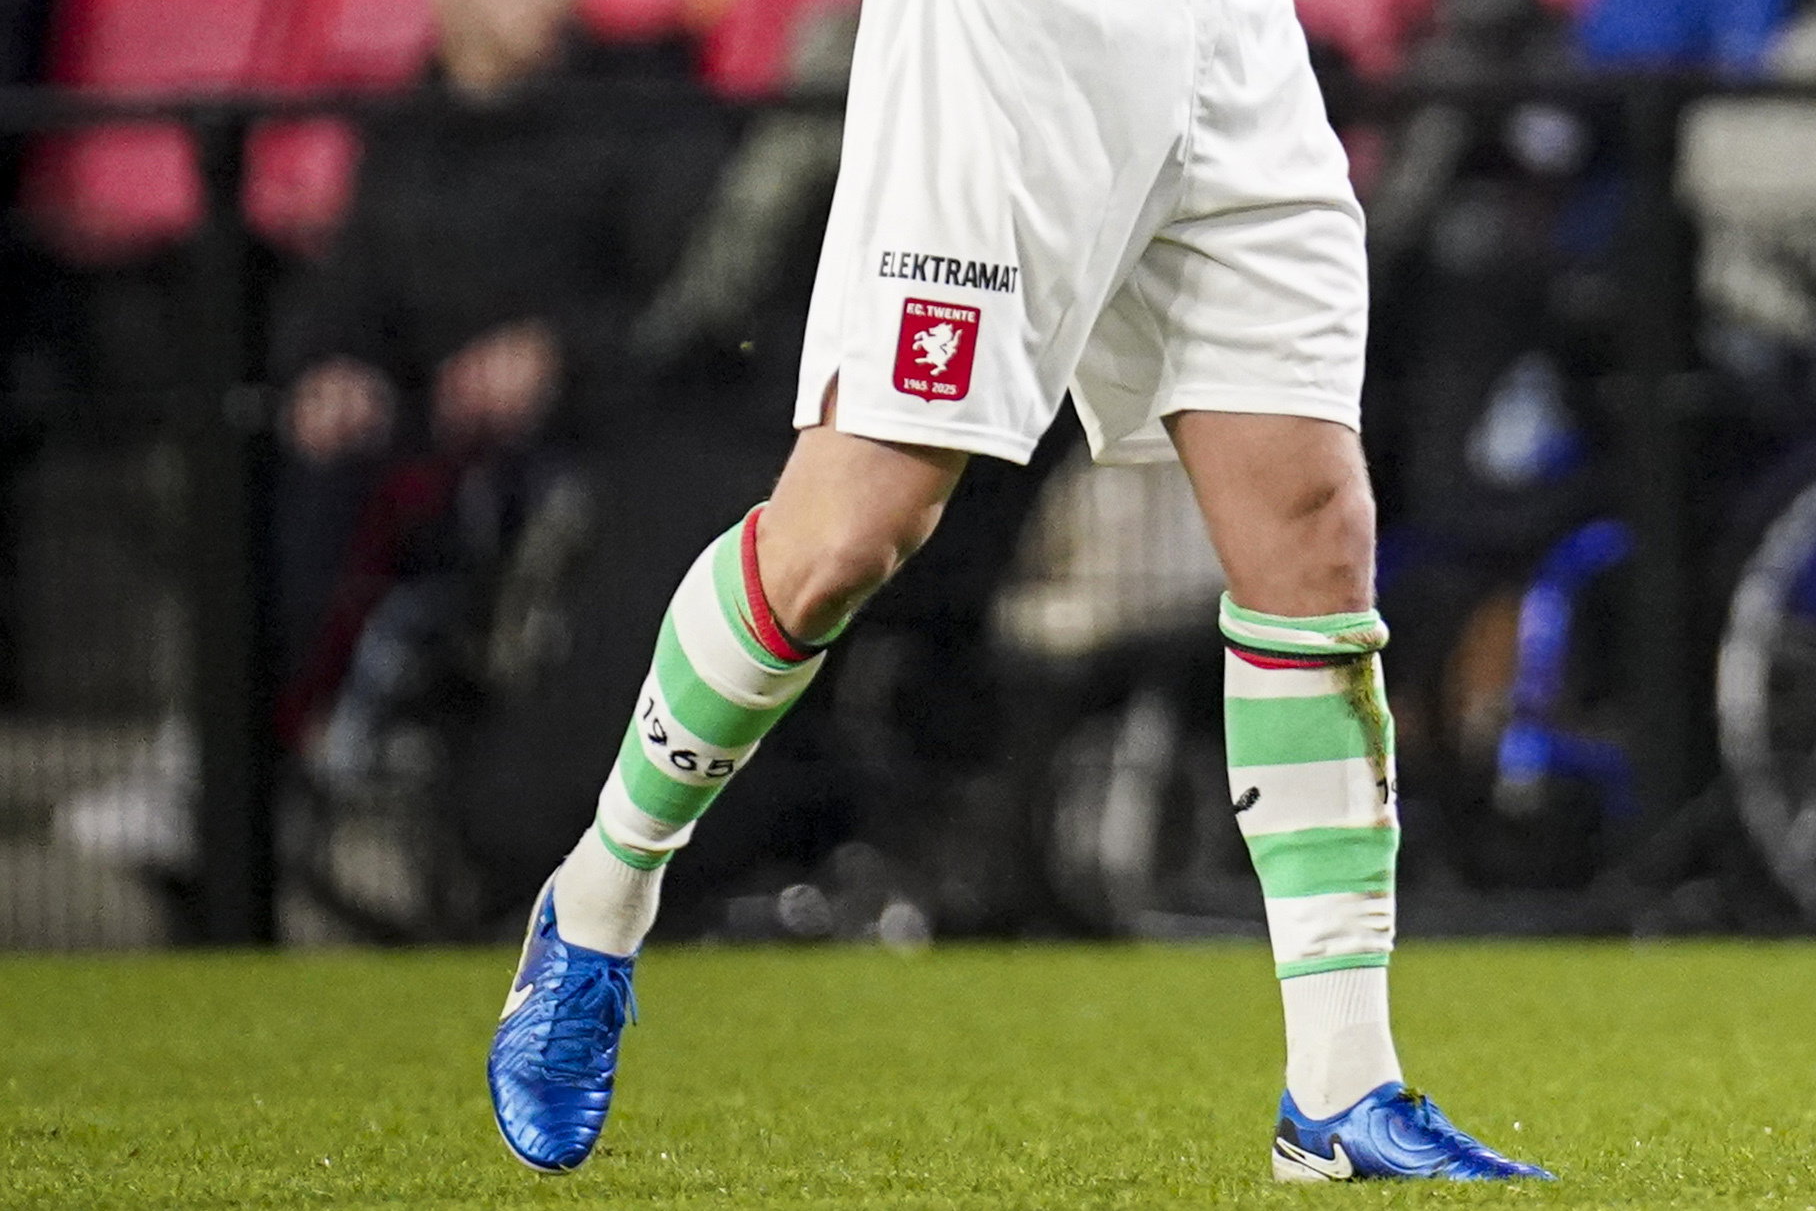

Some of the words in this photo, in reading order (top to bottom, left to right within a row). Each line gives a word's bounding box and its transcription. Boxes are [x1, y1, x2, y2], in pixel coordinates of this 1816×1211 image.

[878, 251, 1018, 294] ELEKTRAMAT
[926, 305, 977, 323] TWENTE
[642, 696, 736, 779] 1965
